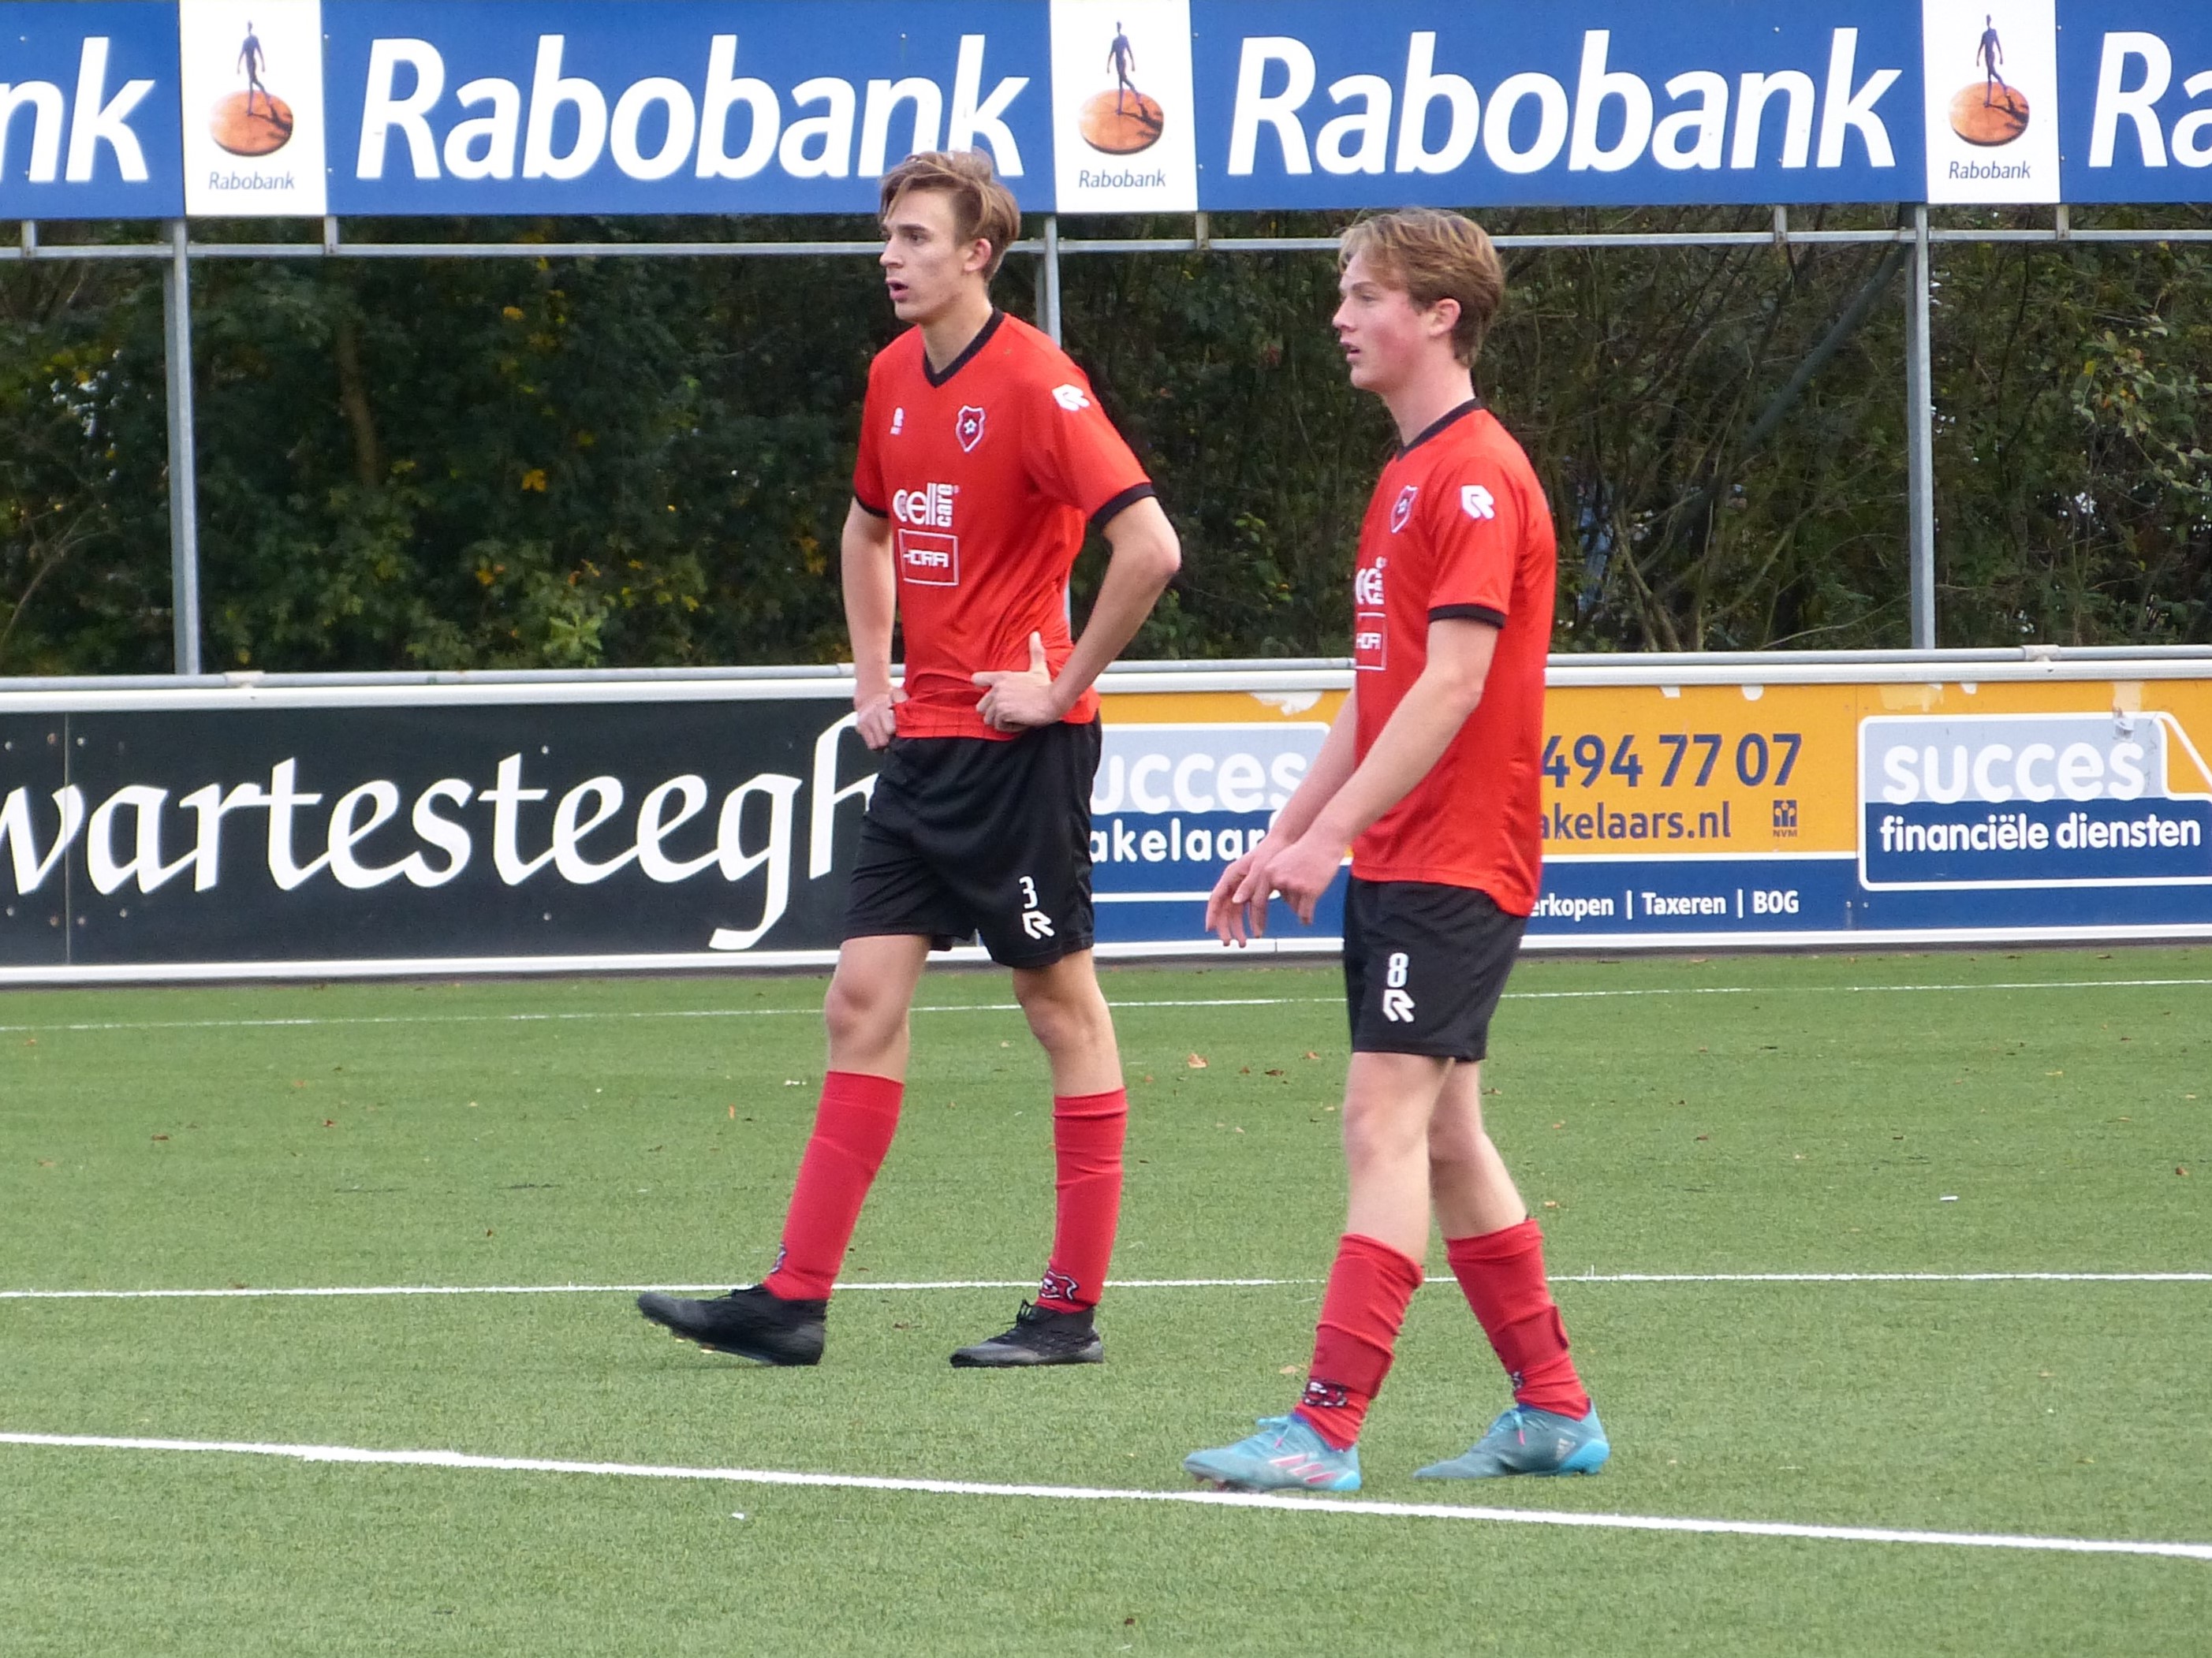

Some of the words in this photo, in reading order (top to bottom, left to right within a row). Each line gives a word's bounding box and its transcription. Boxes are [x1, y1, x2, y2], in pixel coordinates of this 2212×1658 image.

[356, 34, 1029, 181] Rabobank
[1227, 28, 1902, 176] Rabobank
[208, 171, 295, 191] Rabobank
[1078, 169, 1166, 188] Rabobank
[1949, 160, 2031, 180] Rabobank
[1659, 734, 1722, 787] 77
[1736, 732, 1802, 787] 07
[1882, 742, 2145, 804] succes
[1879, 813, 2049, 852] financiële
[2056, 812, 2201, 849] diensten
[1019, 876, 1038, 909] 3
[1641, 892, 1726, 915] Taxeren
[1753, 890, 1799, 914] BOG
[1387, 952, 1408, 987] 8
